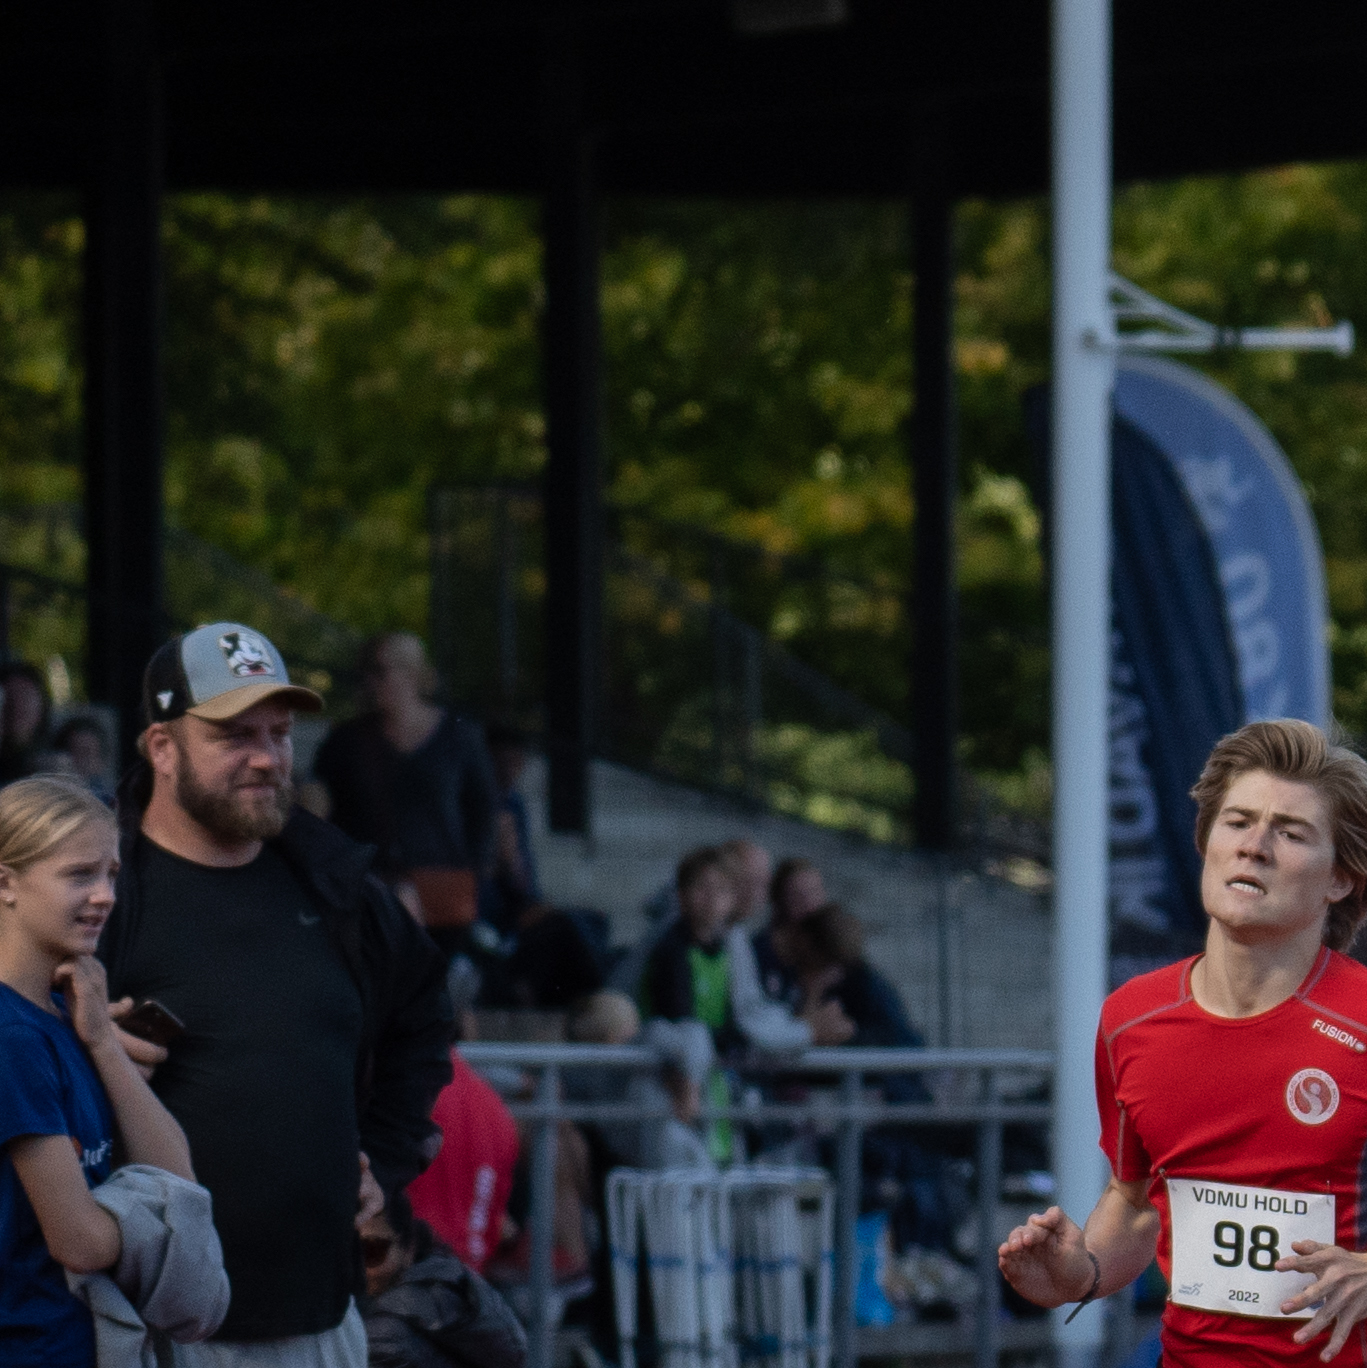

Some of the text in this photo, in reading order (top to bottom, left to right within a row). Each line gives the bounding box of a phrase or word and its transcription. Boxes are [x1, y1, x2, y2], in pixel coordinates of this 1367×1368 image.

[1312, 1019, 1358, 1047] FUSION
[1192, 1186, 1308, 1215] VDMU HOLD
[1213, 1220, 1280, 1271] 98
[1228, 1289, 1260, 1303] 2022
